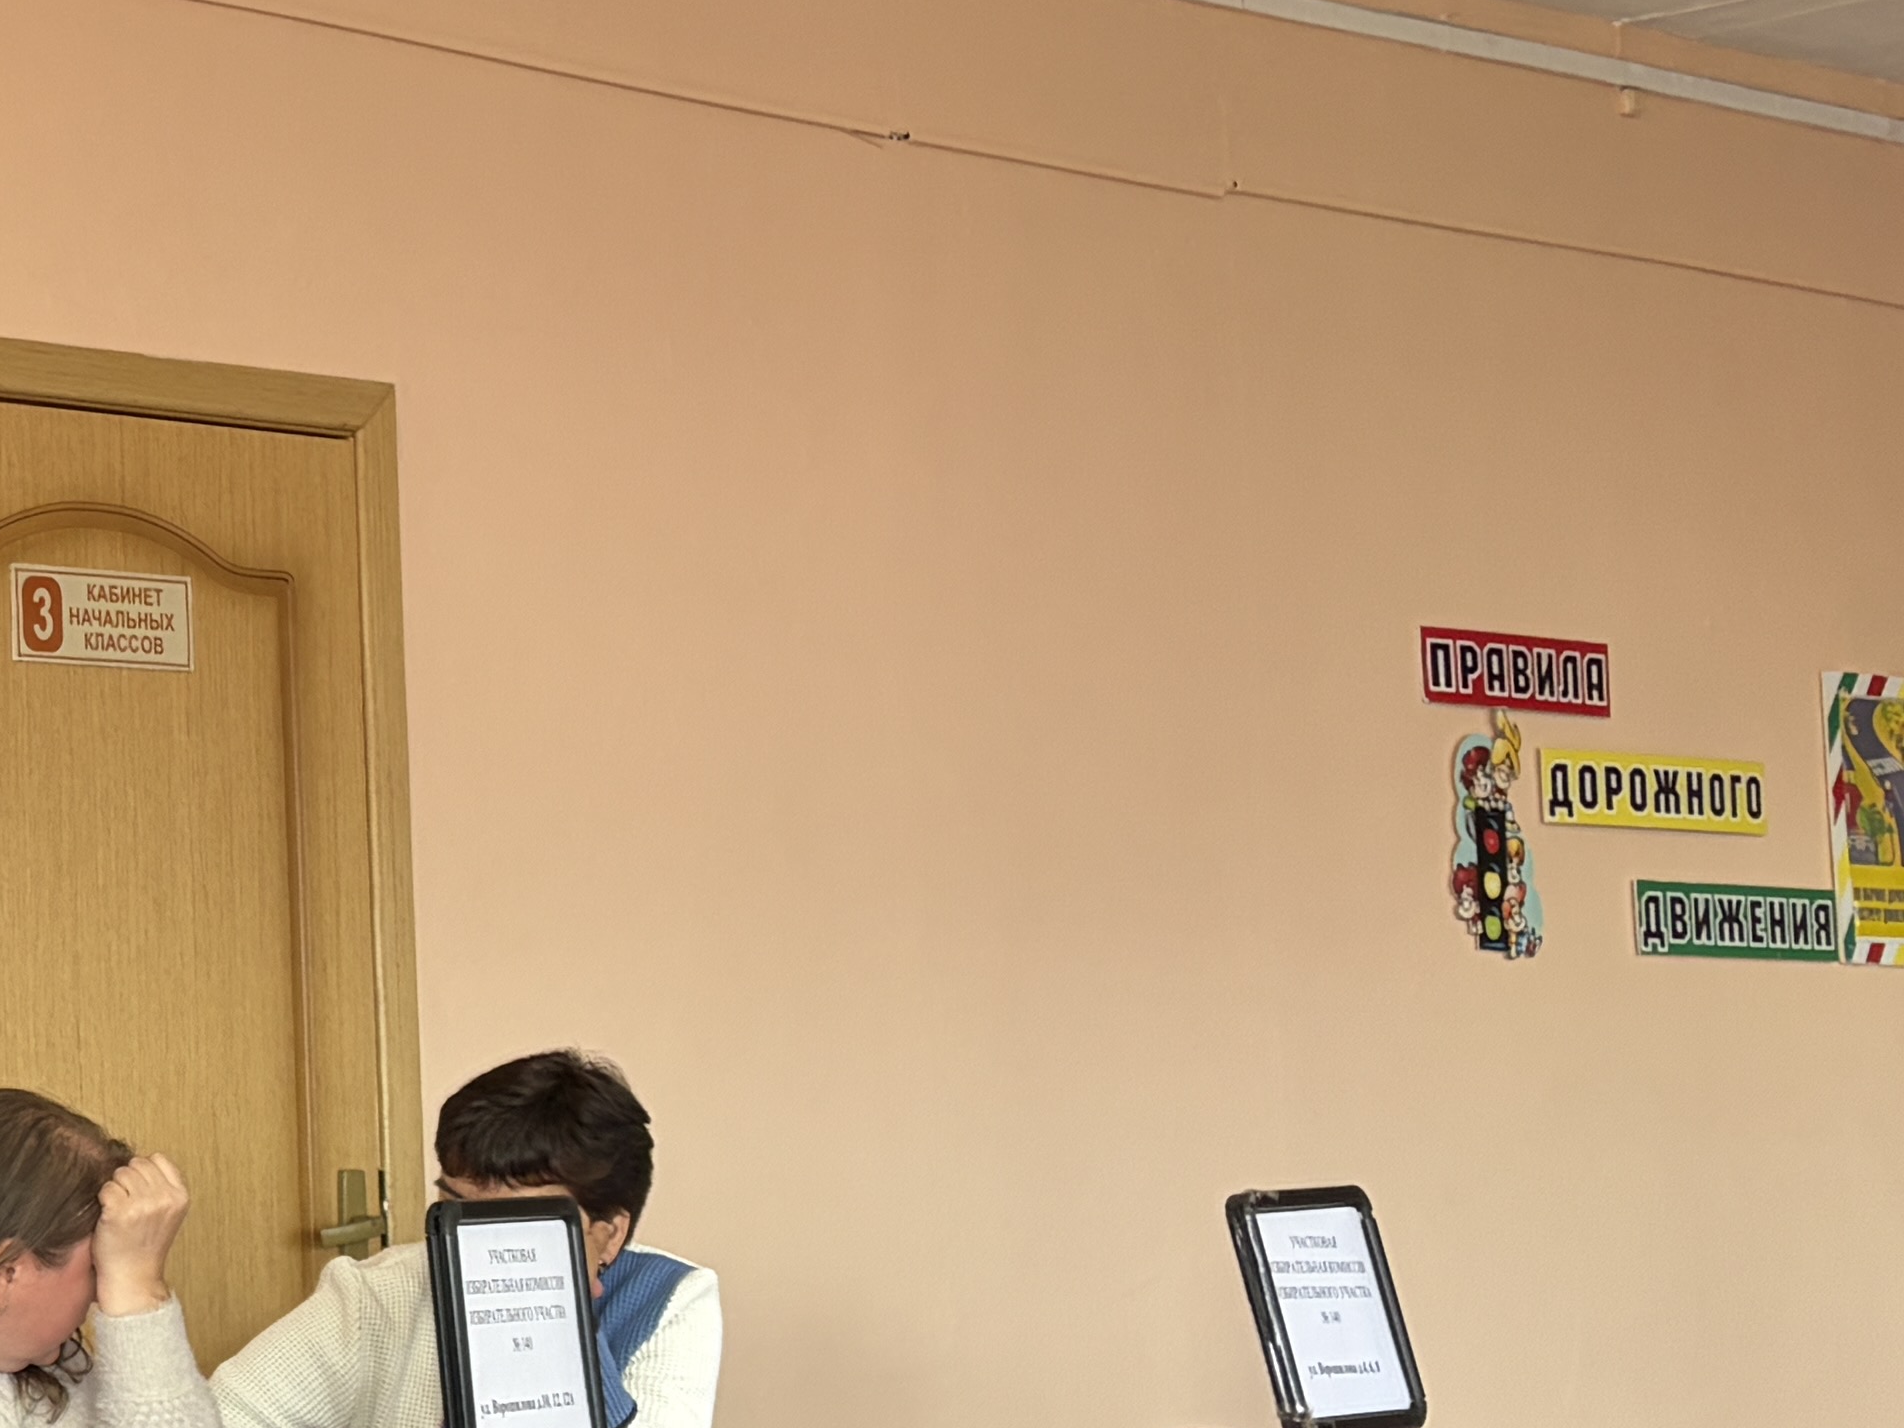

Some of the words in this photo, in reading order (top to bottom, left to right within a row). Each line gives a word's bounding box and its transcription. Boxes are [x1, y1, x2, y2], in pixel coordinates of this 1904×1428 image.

[32, 586, 54, 641] 3
[69, 606, 175, 632] НАЧАЛЬНЫХ
[86, 583, 163, 607] КАБИНЕТ
[84, 632, 164, 655] КЛАССОВ
[1427, 639, 1607, 705] ПРАВИЛА
[1548, 762, 1763, 821] ДОРОЖНОГО
[1641, 892, 1835, 951] ДВИЖЕНИЯ
